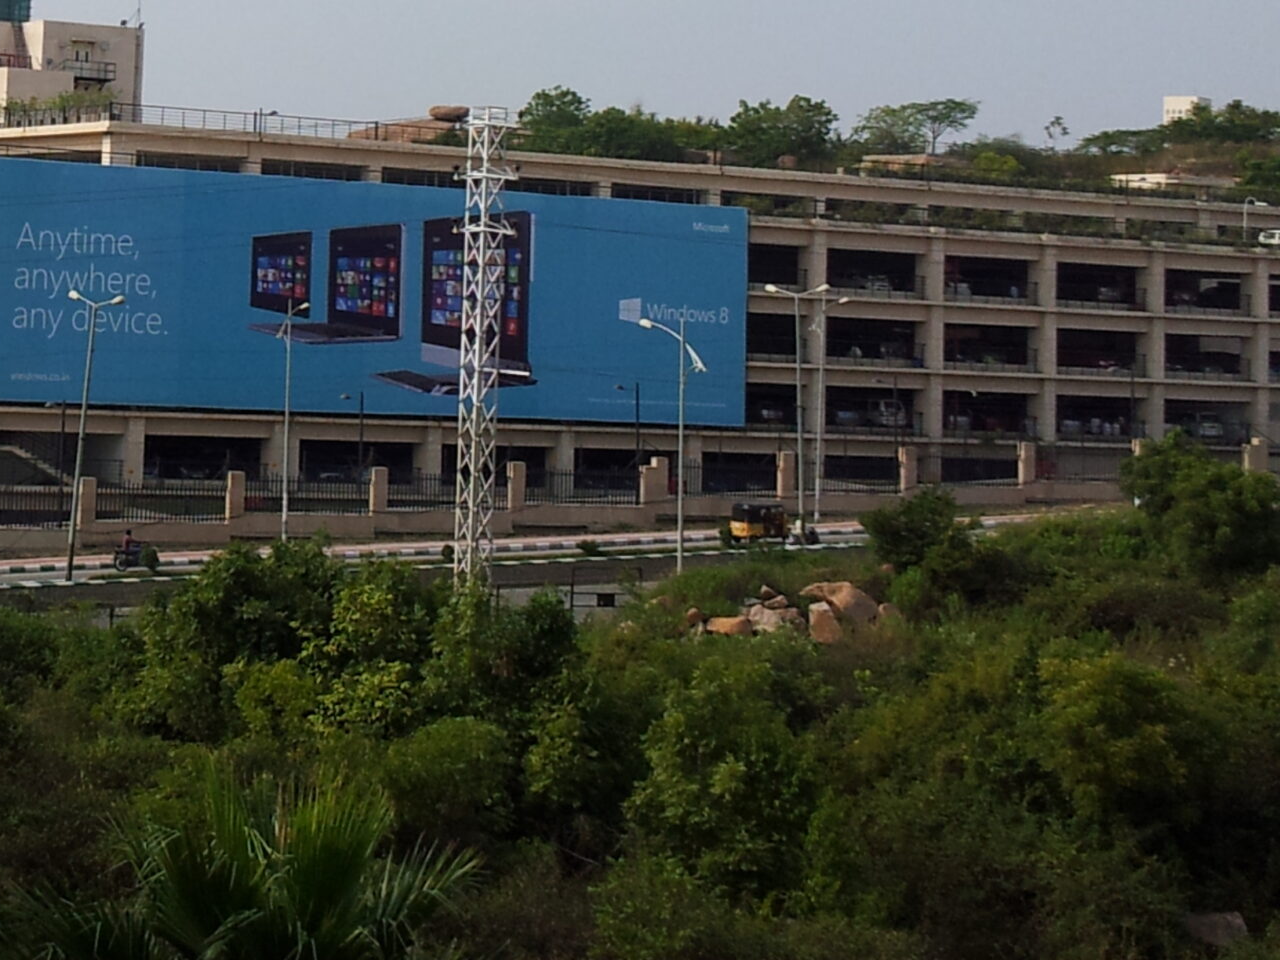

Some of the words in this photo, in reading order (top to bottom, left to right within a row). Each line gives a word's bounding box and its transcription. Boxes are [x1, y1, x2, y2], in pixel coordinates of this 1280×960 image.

[16, 222, 139, 260] Anytime,
[692, 221, 730, 233] Microsoft
[14, 263, 157, 299] anywhere,
[12, 305, 63, 339] any
[71, 303, 168, 335] device.
[646, 303, 716, 323] Windows
[719, 306, 728, 324] 8
